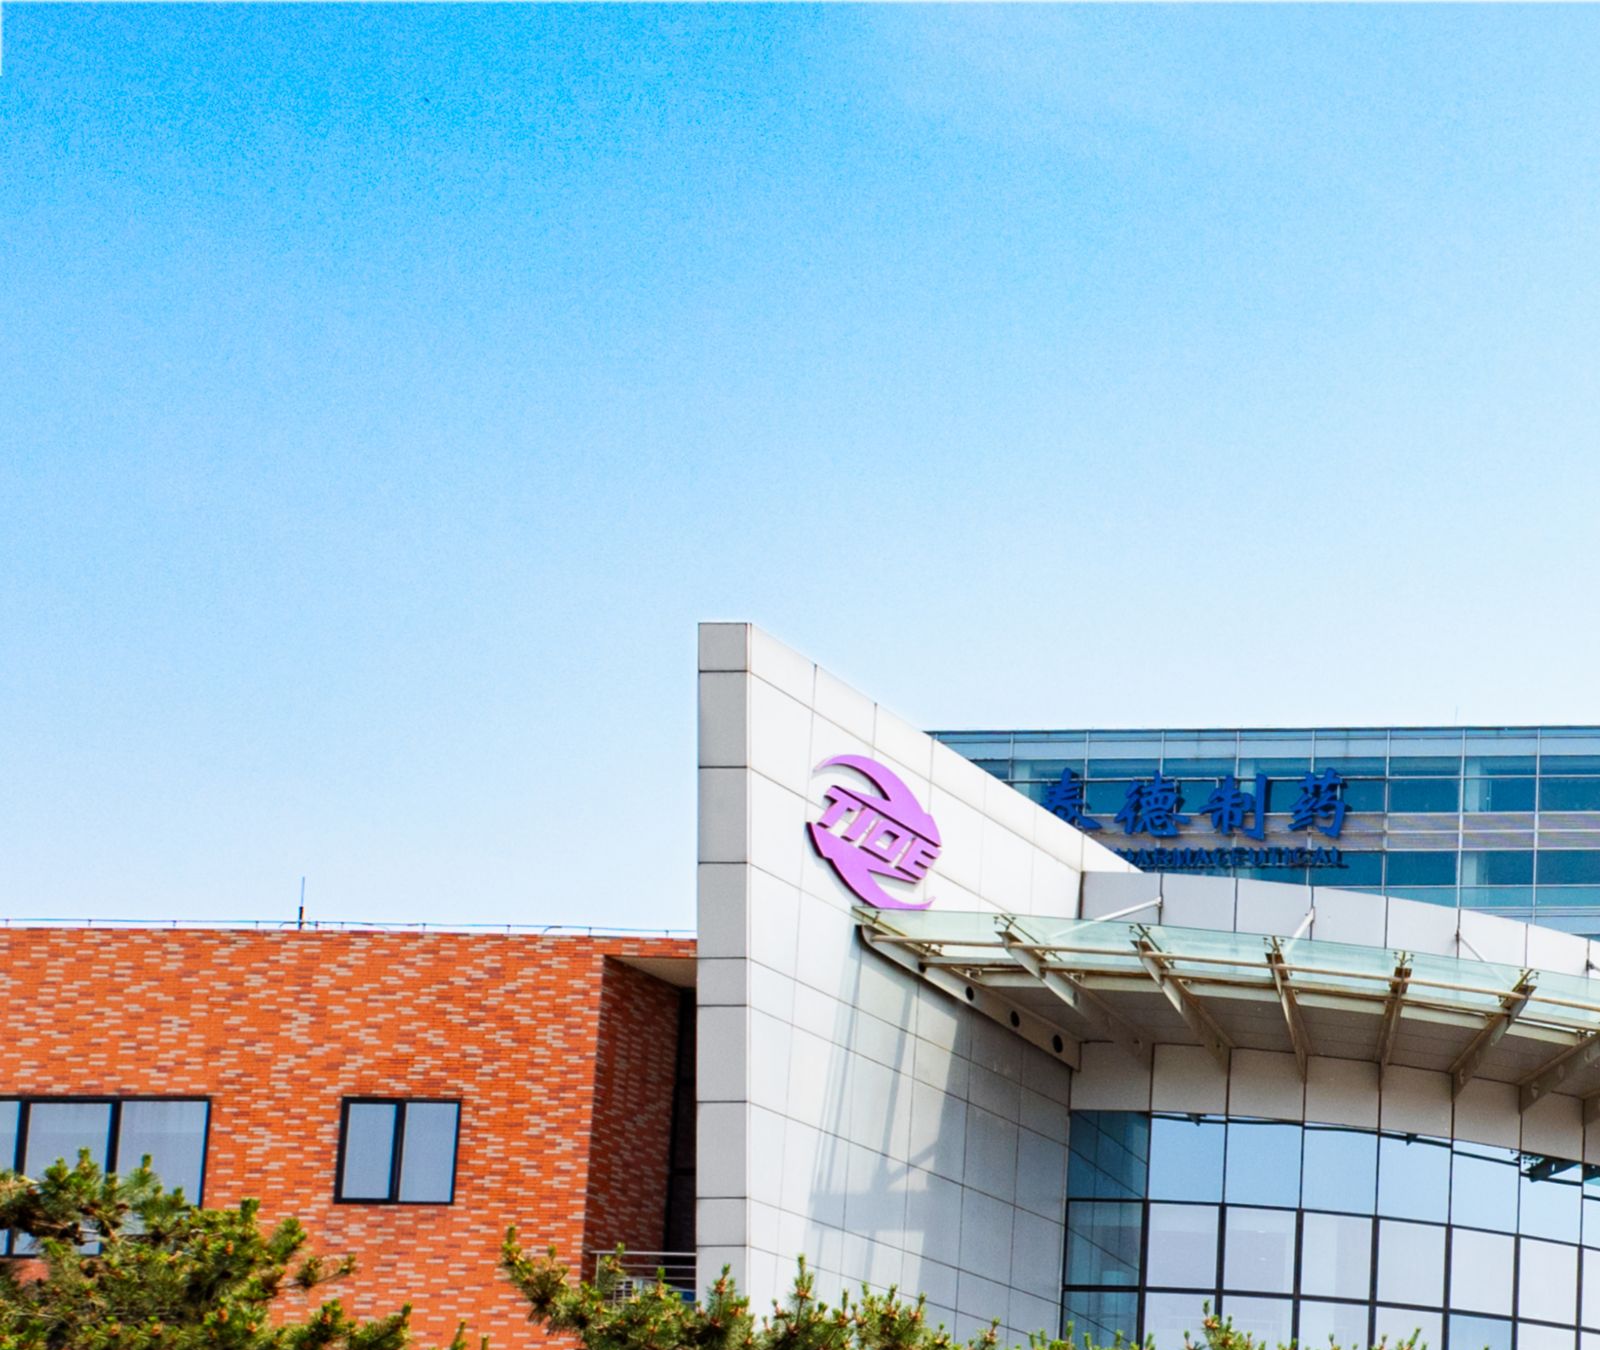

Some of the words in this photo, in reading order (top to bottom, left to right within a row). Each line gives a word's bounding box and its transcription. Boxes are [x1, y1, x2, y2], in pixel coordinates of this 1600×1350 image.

[816, 784, 942, 882] TIDE
[1045, 767, 1347, 841] 泰德制药
